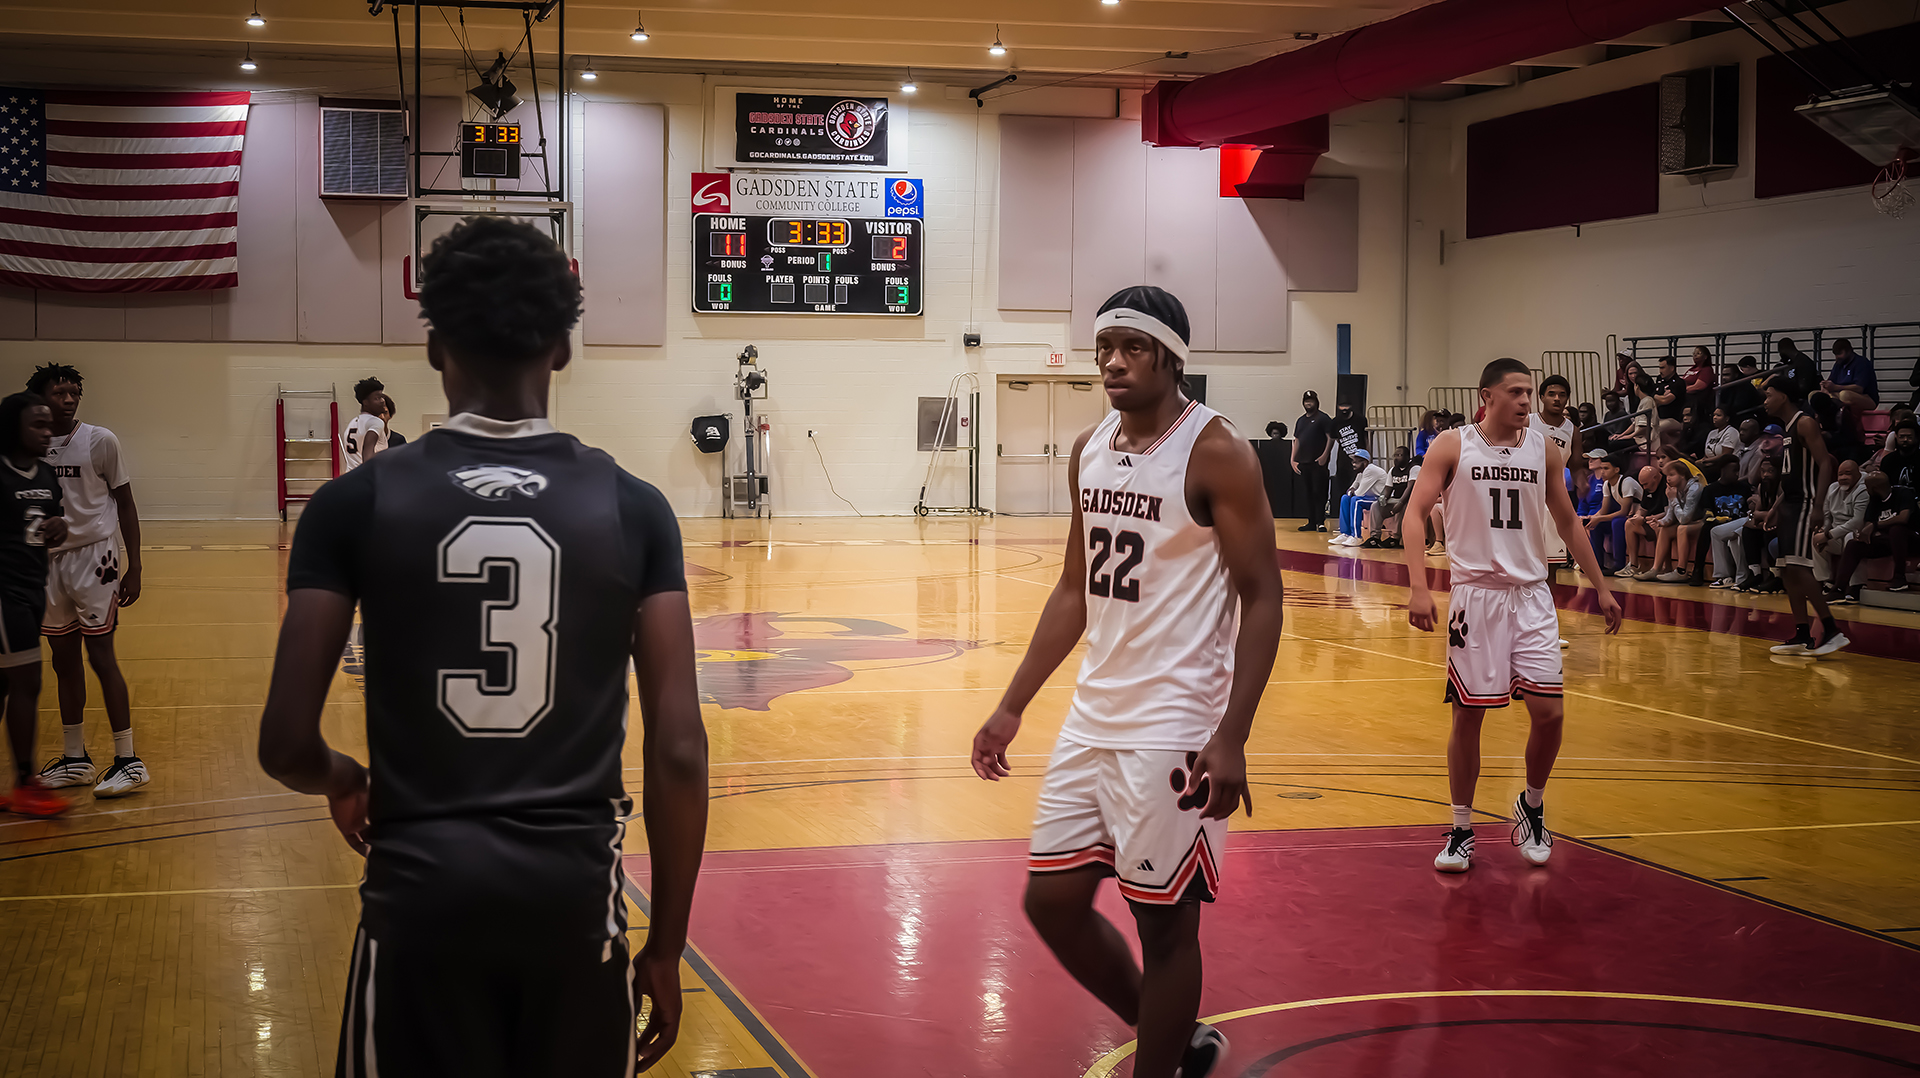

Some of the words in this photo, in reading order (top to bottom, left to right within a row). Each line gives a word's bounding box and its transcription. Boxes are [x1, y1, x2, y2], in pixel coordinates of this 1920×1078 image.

[749, 112, 793, 125] GADSDEN
[795, 113, 825, 126] STATE
[829, 103, 855, 124] GADSDEN
[856, 105, 872, 125] STATE
[475, 126, 519, 142] 3:33
[750, 126, 824, 135] CARDINALS
[831, 131, 870, 147] CARDINALS
[749, 152, 875, 161] GOCARDINALS.GADSDENSTATE.EDU
[736, 177, 820, 197] GADSDEN
[824, 180, 879, 199] STATE
[755, 199, 816, 211] COMMUNITY
[817, 201, 860, 212] COLLEGE
[887, 205, 920, 216] pepsi
[710, 217, 746, 230] HOME
[865, 221, 912, 234] VISITOR
[788, 221, 845, 244] 3:33
[725, 234, 746, 256] 11
[892, 237, 906, 259] 2
[721, 260, 747, 268] BONUS
[787, 256, 815, 265] PERIOD
[825, 254, 831, 271] 1
[871, 263, 896, 271] BONUS
[708, 274, 732, 282] FOULS
[766, 275, 794, 283] PLAYER
[802, 276, 830, 284] POINTS
[835, 276, 859, 284] FOULS
[885, 277, 909, 285] FOULS
[720, 283, 731, 301] 0
[897, 286, 908, 304] 3
[1050, 353, 1063, 364] EXIT
[346, 428, 358, 454] 5
[1471, 466, 1538, 484] GADSDEN
[1081, 488, 1163, 522] GADSDEN
[1489, 488, 1523, 530] 11
[23, 505, 46, 547] 2
[1088, 526, 1145, 603] 22
[437, 515, 561, 738] 3
